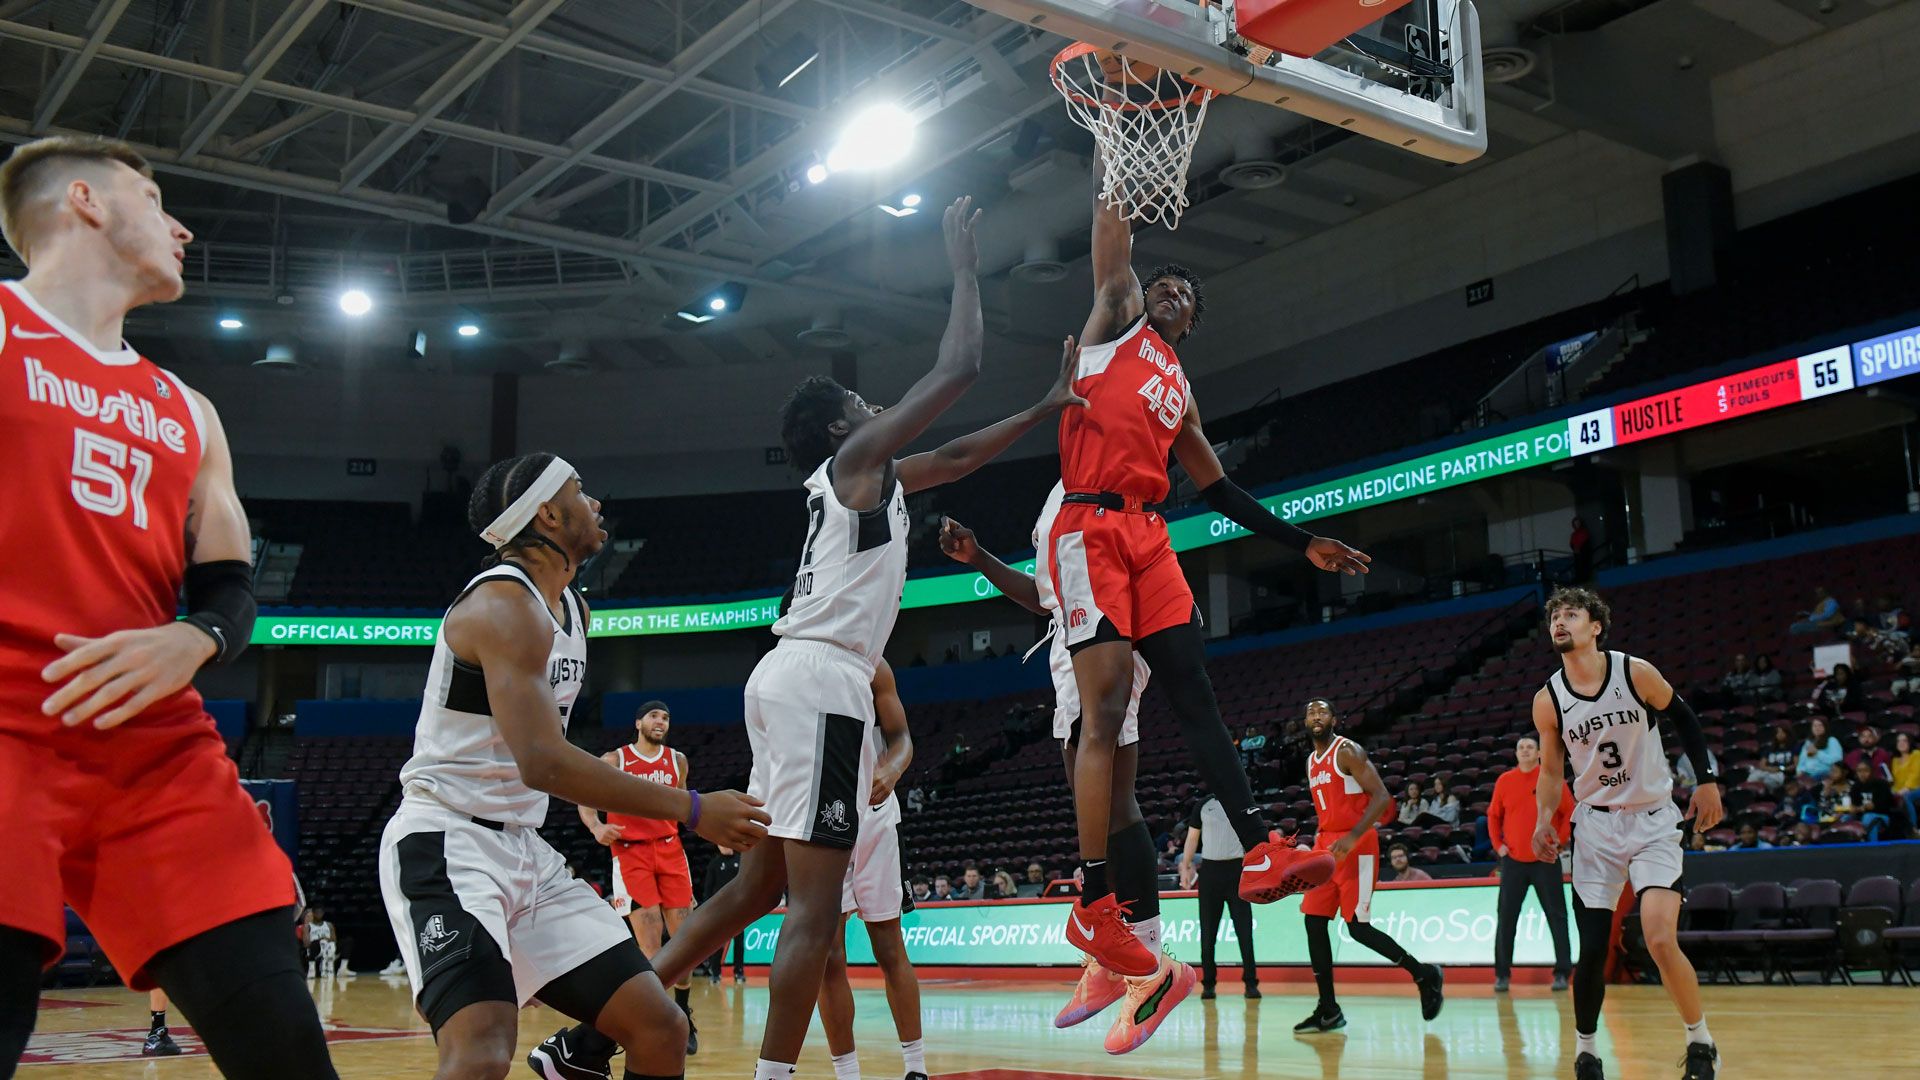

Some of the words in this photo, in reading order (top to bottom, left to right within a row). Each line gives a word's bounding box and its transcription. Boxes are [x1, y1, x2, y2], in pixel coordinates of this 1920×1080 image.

[1717, 385, 1726, 399] 4
[1729, 369, 1795, 394] TIMEOUTS
[1813, 359, 1839, 388] 55
[23, 356, 187, 454] hustle
[1137, 373, 1183, 430] 45
[1718, 398, 1728, 413] 5
[1730, 389, 1770, 408] FOULS
[1621, 396, 1683, 436] HUSTLE
[1580, 419, 1600, 445] 43
[71, 427, 153, 530] 51
[1282, 488, 1344, 520] SPORTS
[1348, 466, 1436, 504] MEDICINE
[1441, 440, 1529, 480] PARTNER
[271, 624, 358, 640] OFFICIAL
[363, 625, 433, 640] SPORTS
[608, 616, 643, 632] FOR
[648, 614, 680, 628] THE
[684, 608, 757, 626] MEMPHIS
[1568, 709, 1640, 743] AUSTIN
[1598, 741, 1622, 769] 3
[1598, 769, 1631, 787] Self.
[1316, 789, 1327, 811] 1
[969, 924, 1040, 946] SPORTS
